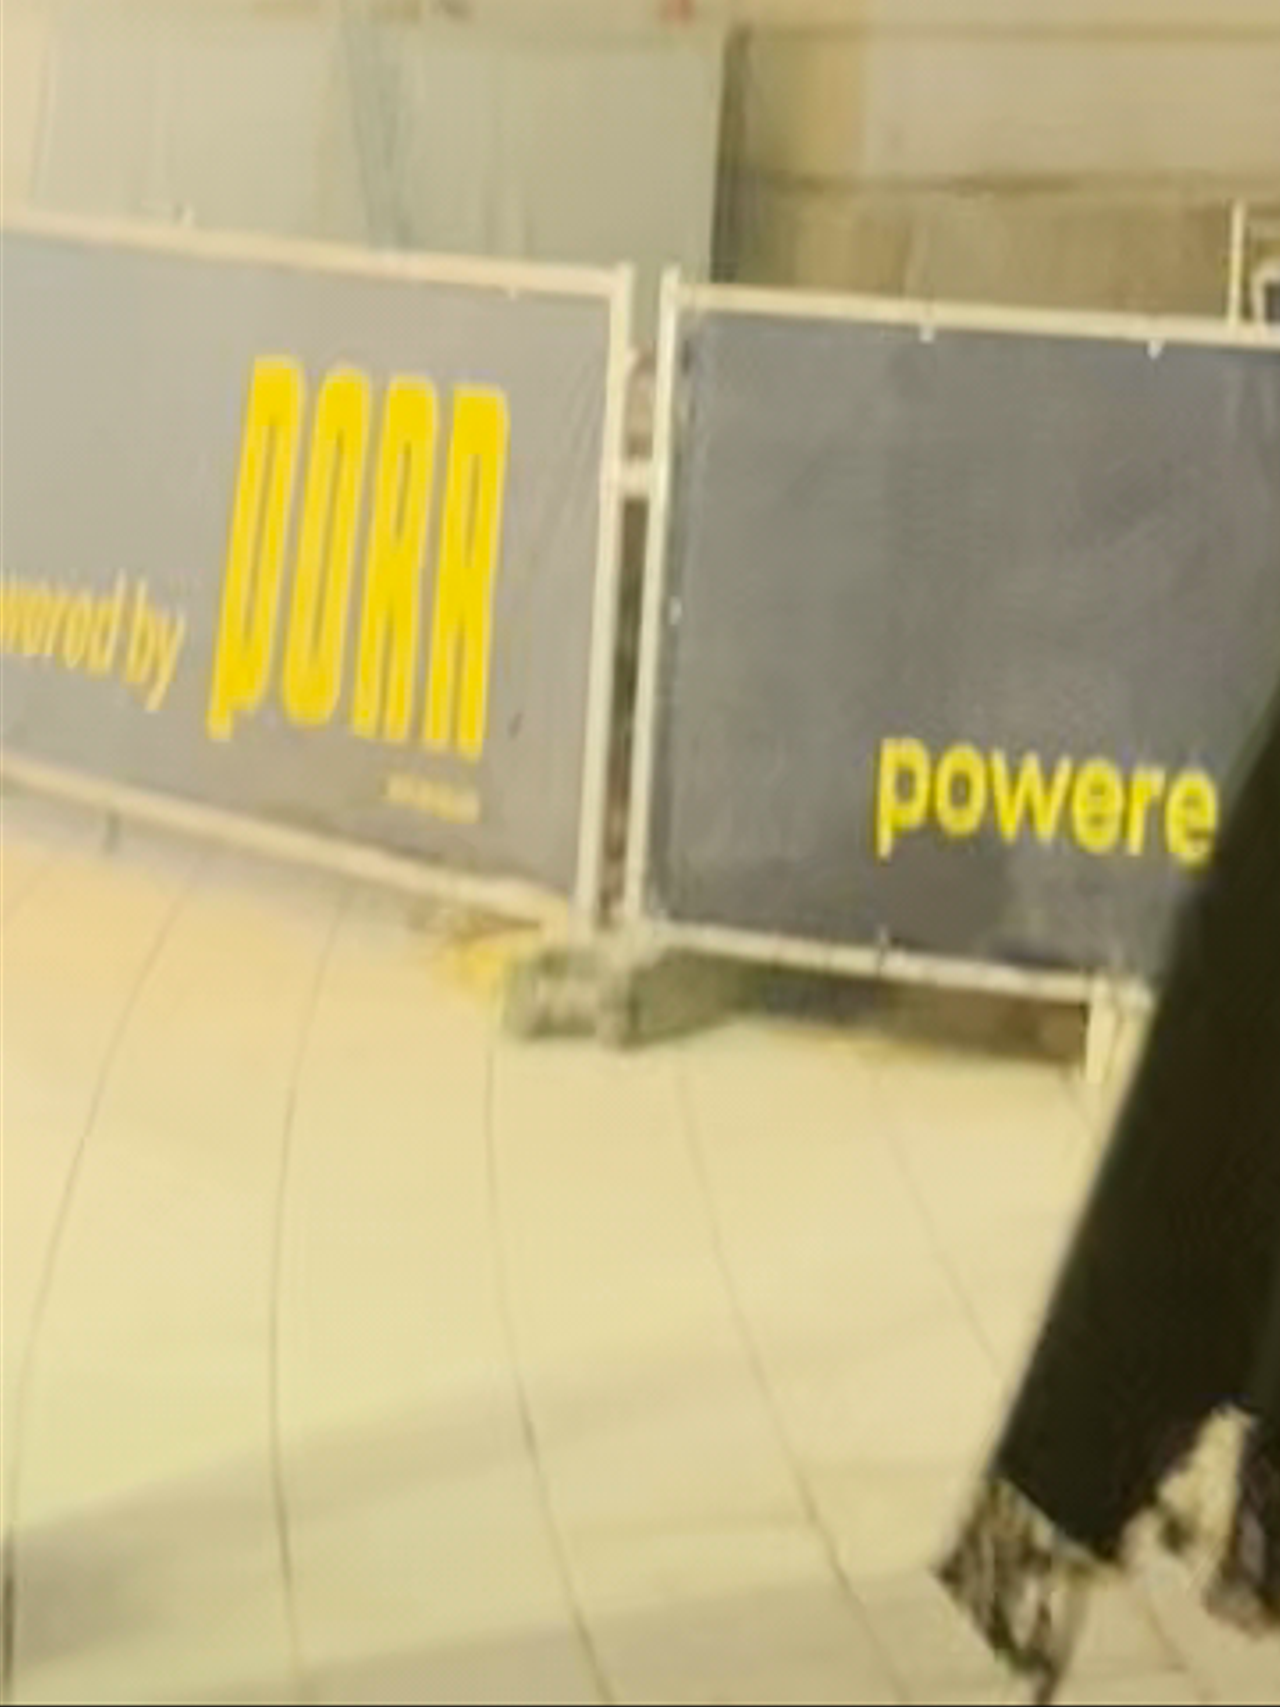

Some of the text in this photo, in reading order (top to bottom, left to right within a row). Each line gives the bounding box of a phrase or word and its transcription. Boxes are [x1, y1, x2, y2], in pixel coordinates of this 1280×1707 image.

[125, 578, 186, 713] by
[206, 354, 510, 764] PORR
[876, 737, 1219, 866] powere
